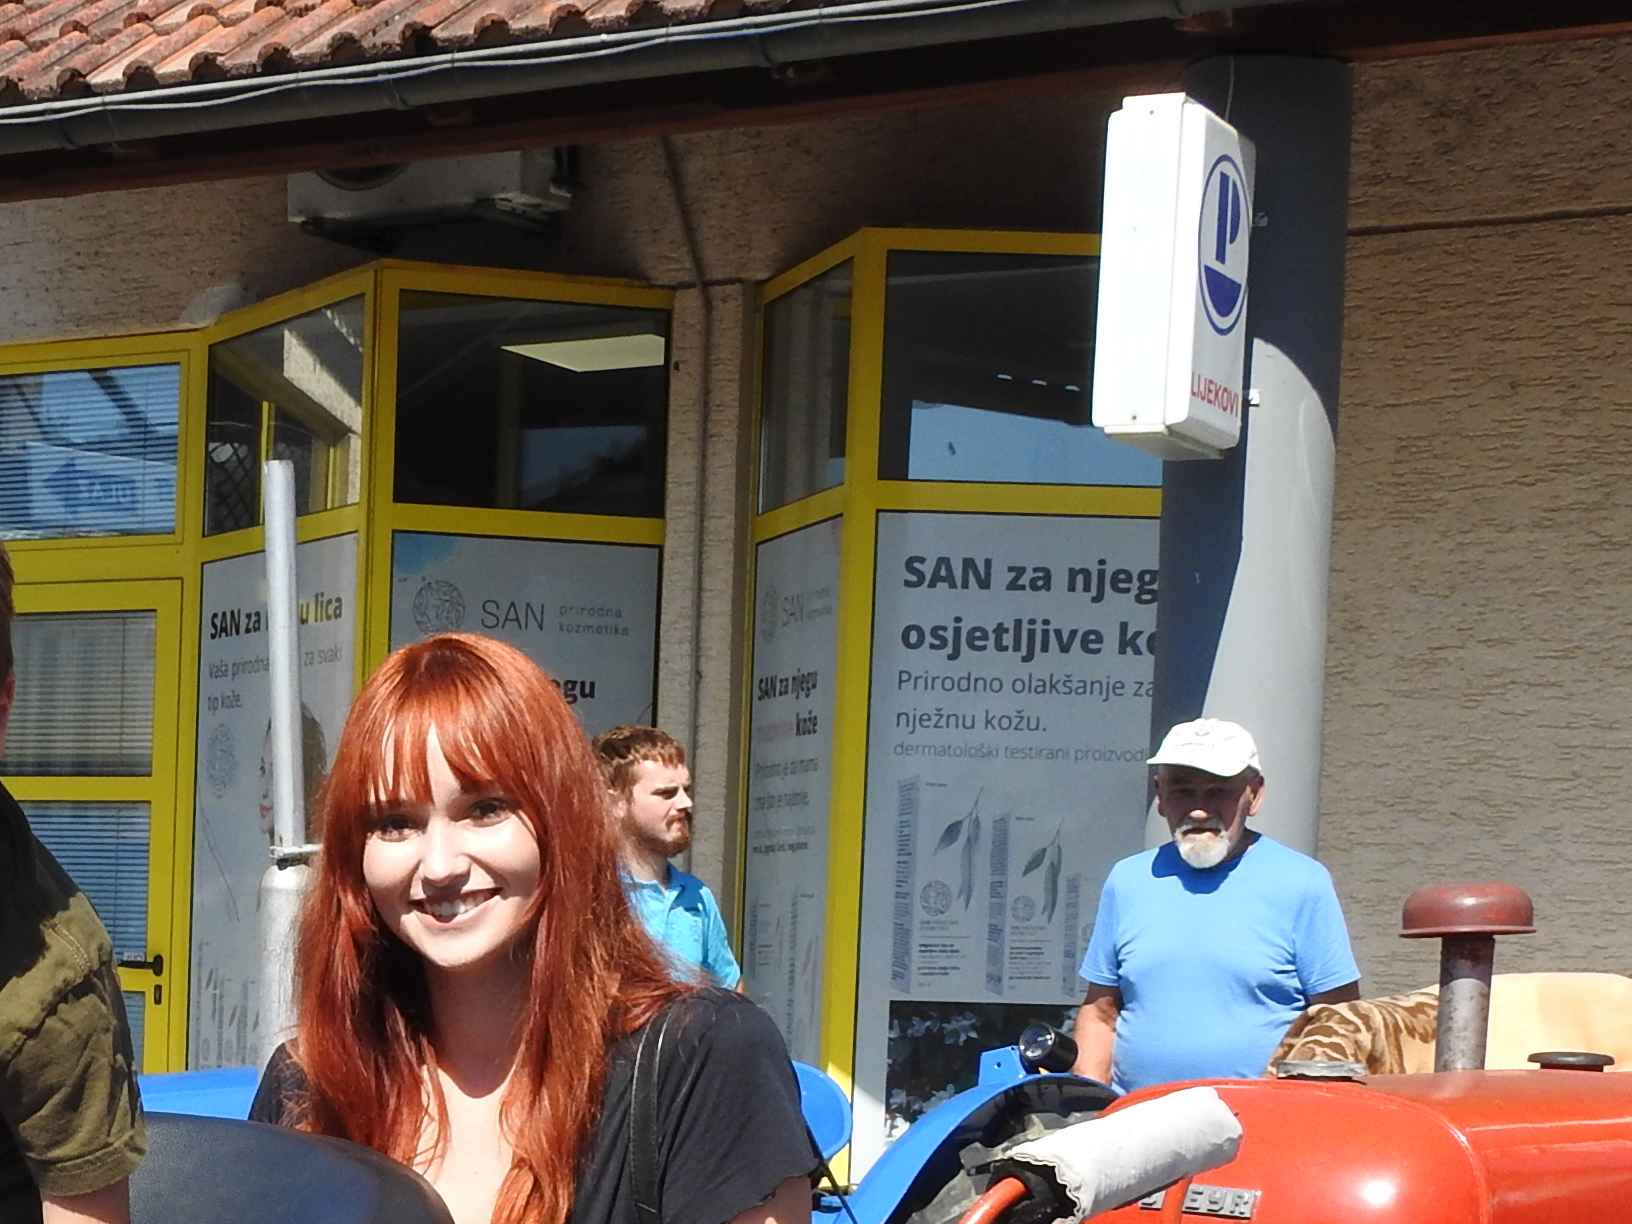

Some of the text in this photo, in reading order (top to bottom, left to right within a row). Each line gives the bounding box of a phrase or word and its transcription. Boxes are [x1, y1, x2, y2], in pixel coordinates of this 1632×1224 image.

[1190, 371, 1240, 417] LIJEKOVI
[902, 555, 993, 590] SAN
[1005, 565, 1053, 592] za
[210, 608, 242, 640] SAN
[244, 610, 262, 634] za
[313, 591, 344, 623] lica
[480, 599, 545, 632] SAN
[900, 616, 1104, 662] osjetljive
[757, 674, 778, 702] SAN
[778, 678, 789, 697] za
[897, 670, 1004, 694] Prirodno
[1011, 673, 1126, 702] olakšanje
[795, 709, 818, 737] kože
[895, 709, 1047, 735] nježnu kožu.
